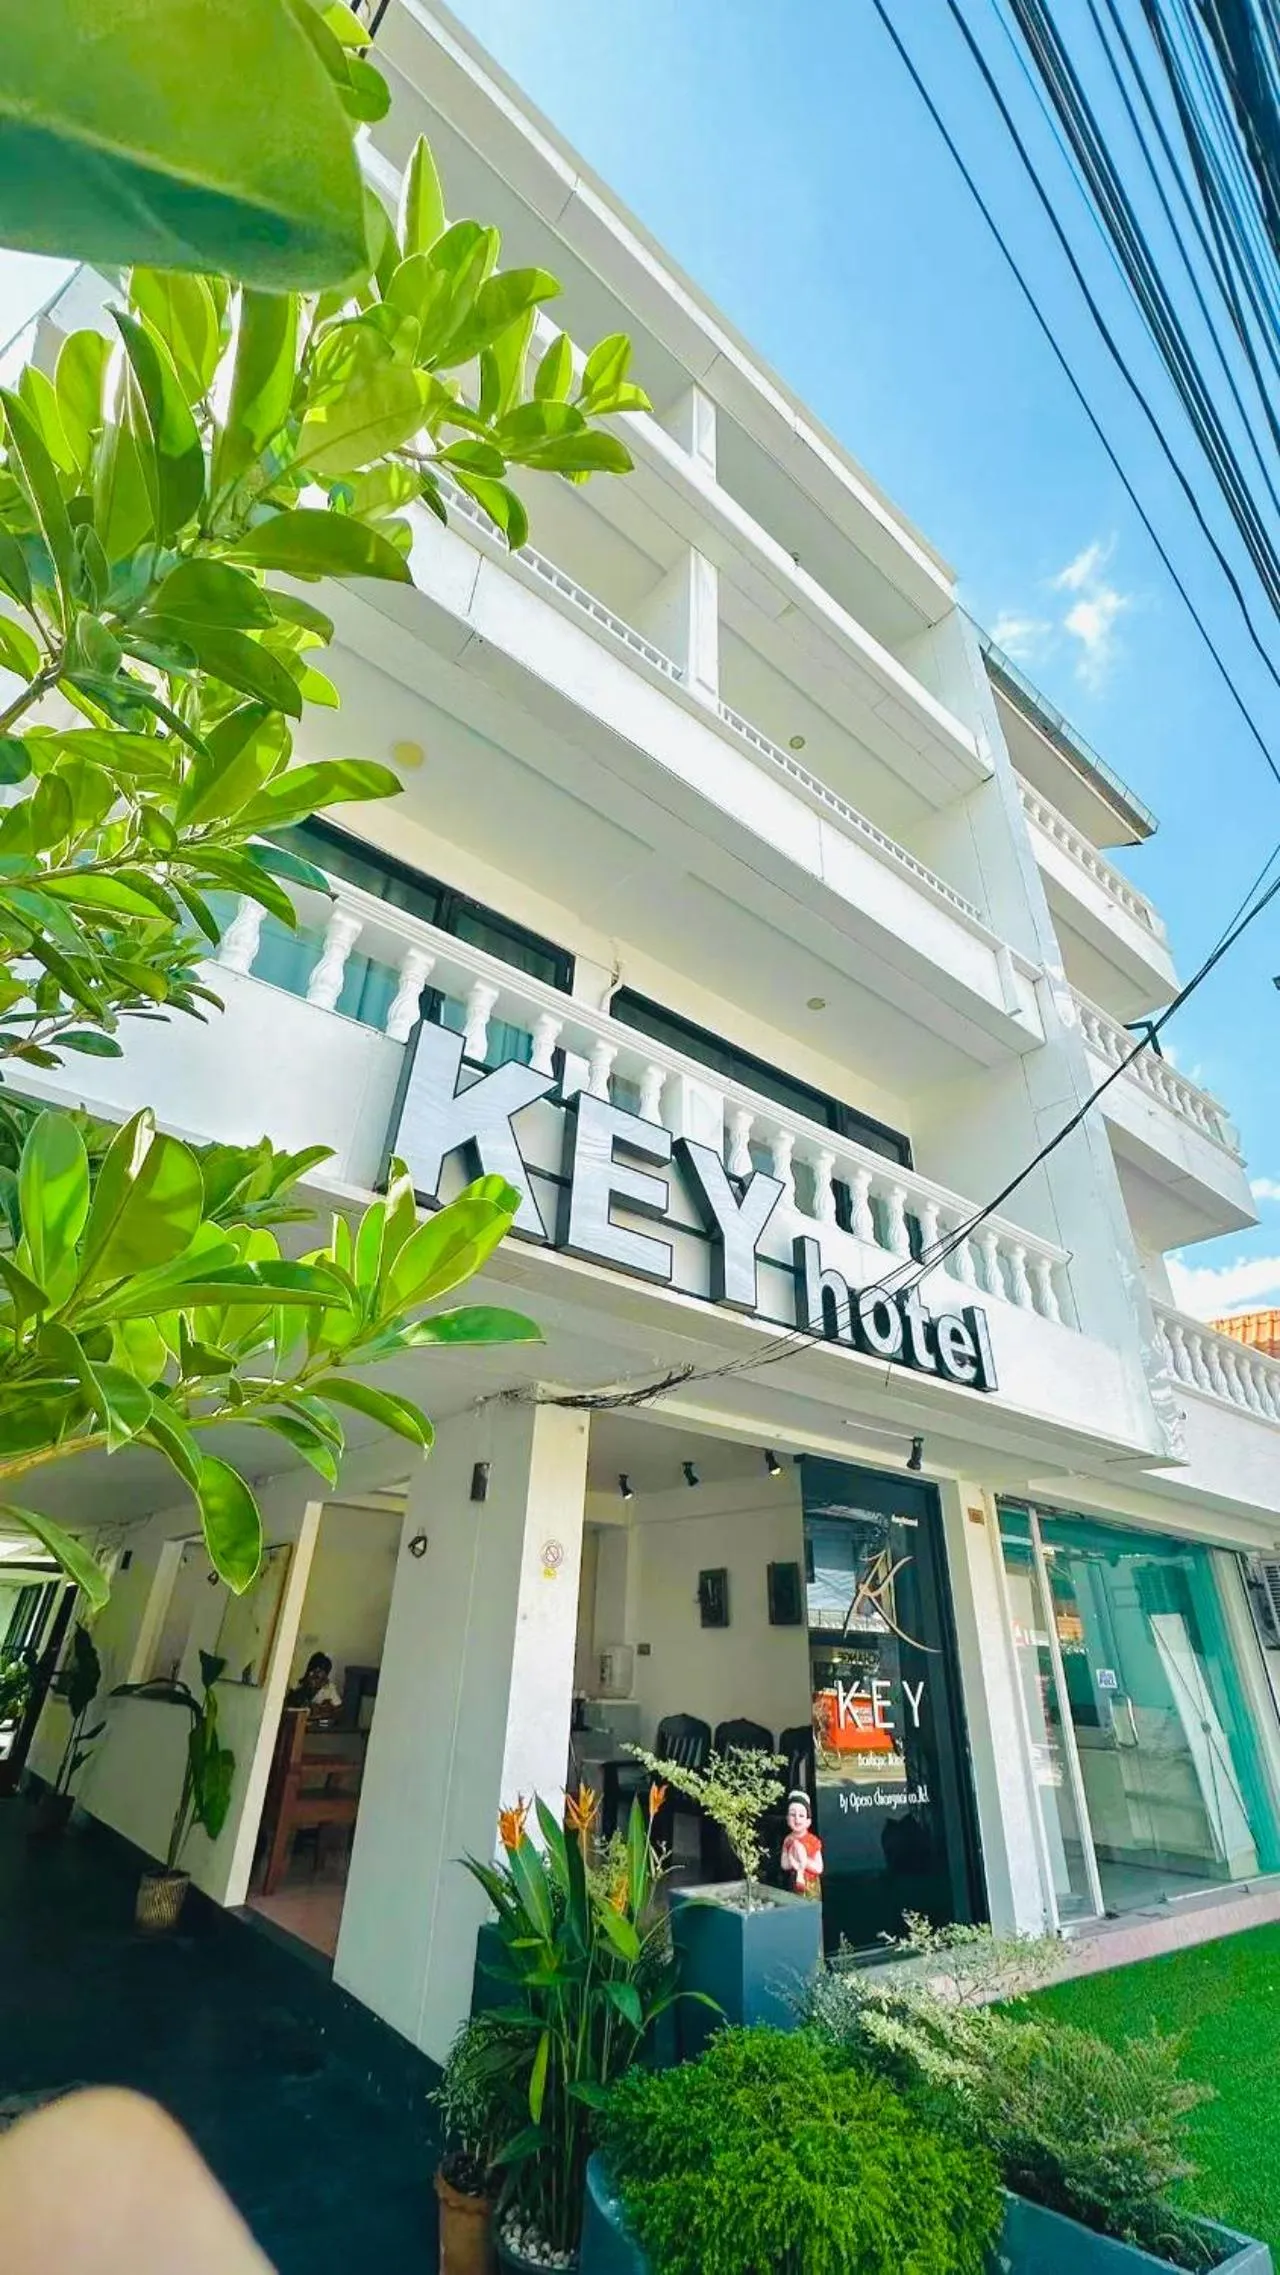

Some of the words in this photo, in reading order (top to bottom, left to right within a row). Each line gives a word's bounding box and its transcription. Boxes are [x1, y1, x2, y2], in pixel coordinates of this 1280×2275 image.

[376, 1017, 786, 1313] KEY
[793, 1235, 998, 1393] hotel
[835, 1680, 924, 1730] KEY
